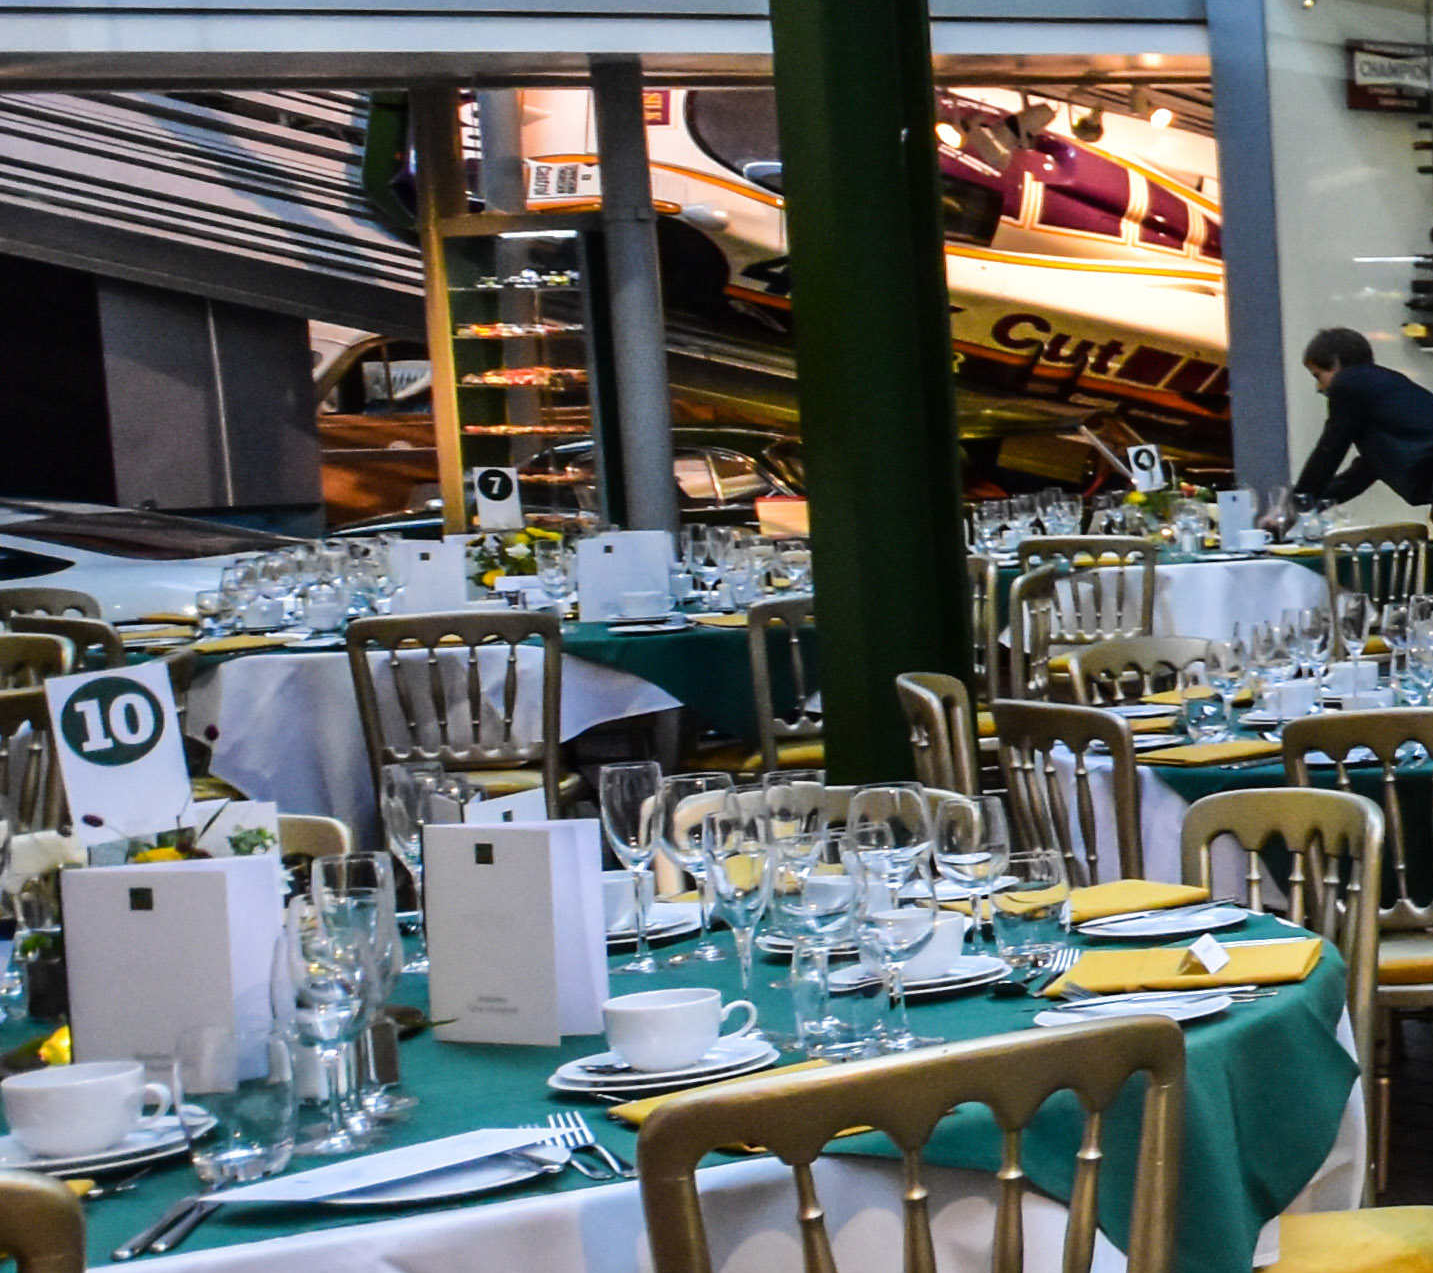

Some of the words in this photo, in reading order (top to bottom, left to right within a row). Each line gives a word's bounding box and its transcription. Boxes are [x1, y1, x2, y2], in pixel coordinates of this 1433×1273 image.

[991, 312, 1125, 376] Cut
[487, 476, 501, 495] 7
[72, 691, 156, 754] 10
